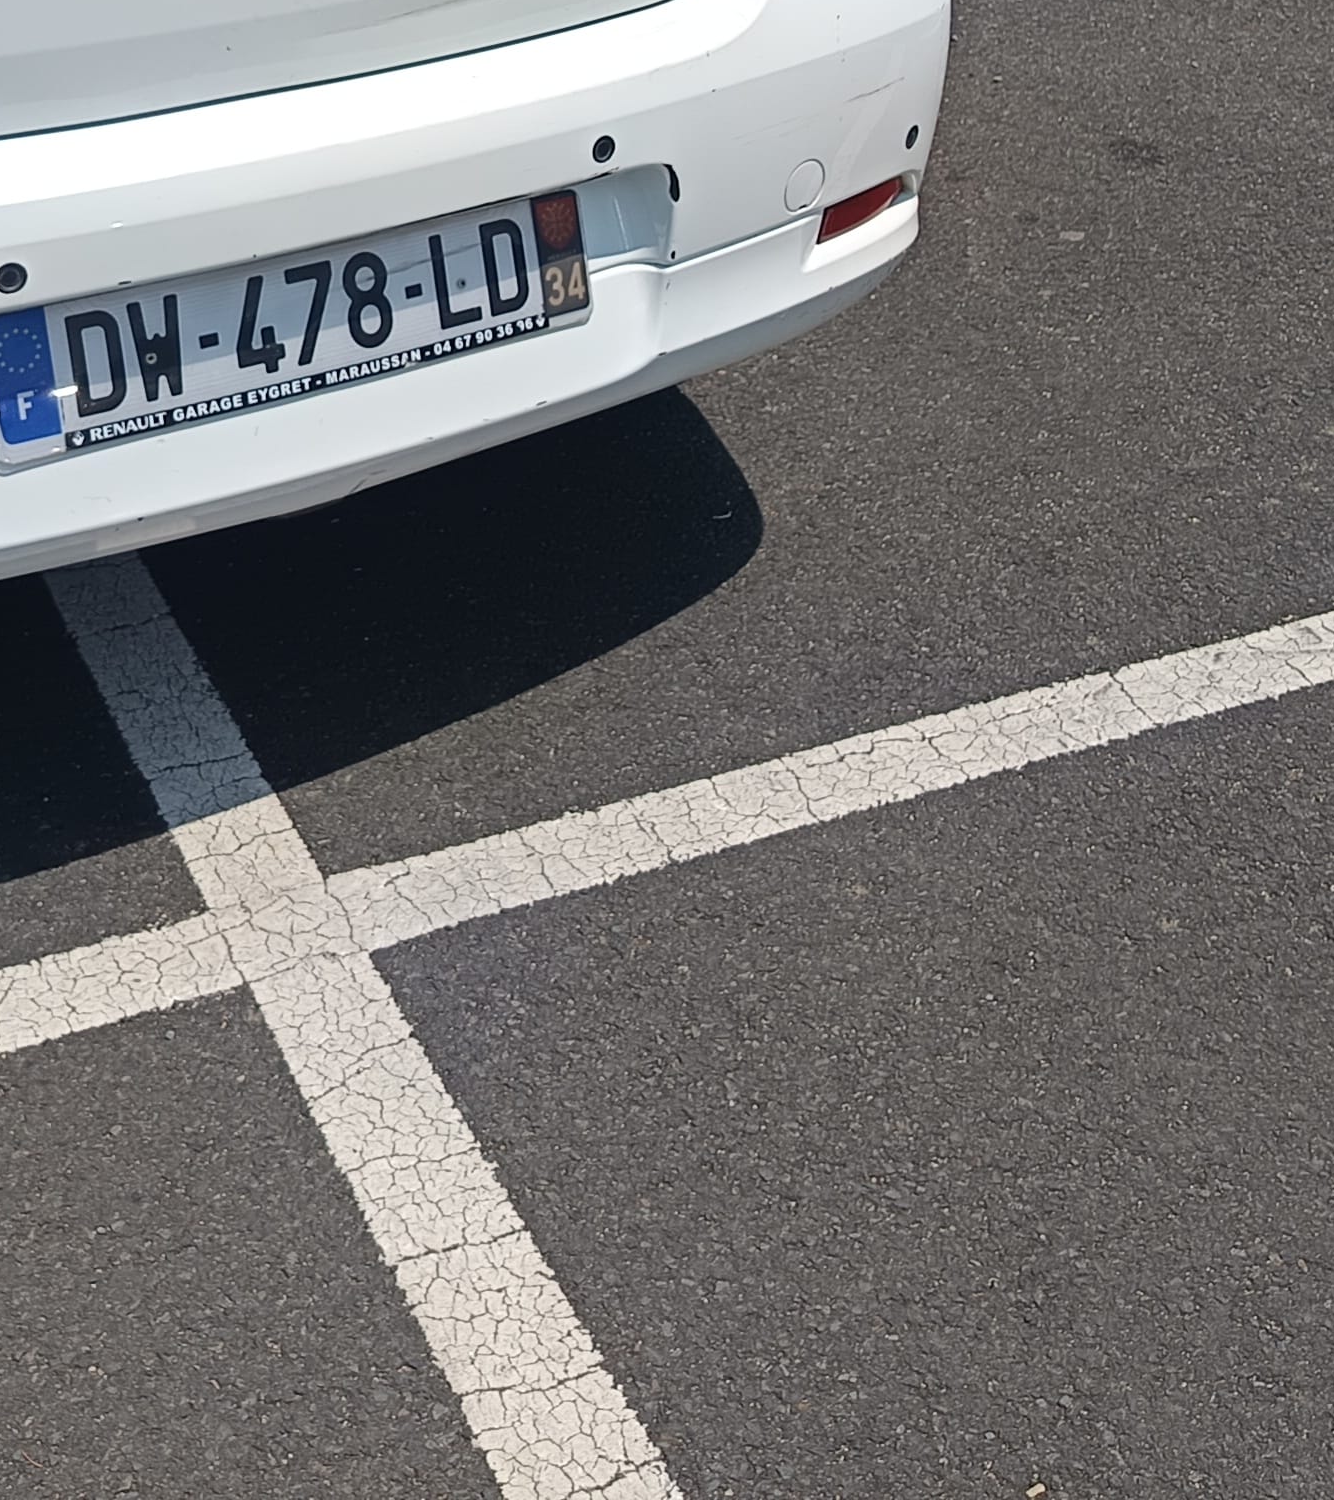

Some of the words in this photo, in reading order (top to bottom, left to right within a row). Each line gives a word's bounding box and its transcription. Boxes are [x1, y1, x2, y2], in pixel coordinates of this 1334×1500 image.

[64, 218, 530, 418] DW-478-LD
[545, 262, 585, 306] 34
[17, 391, 36, 422] F
[89, 411, 167, 442] RENAULT
[173, 396, 244, 422] GARAGE
[247, 378, 312, 405] EYGRET
[325, 348, 421, 385] MARAUSSAN
[433, 341, 452, 356] 04
[454, 334, 472, 350] 67
[476, 329, 494, 344] 90
[496, 322, 514, 337] 36
